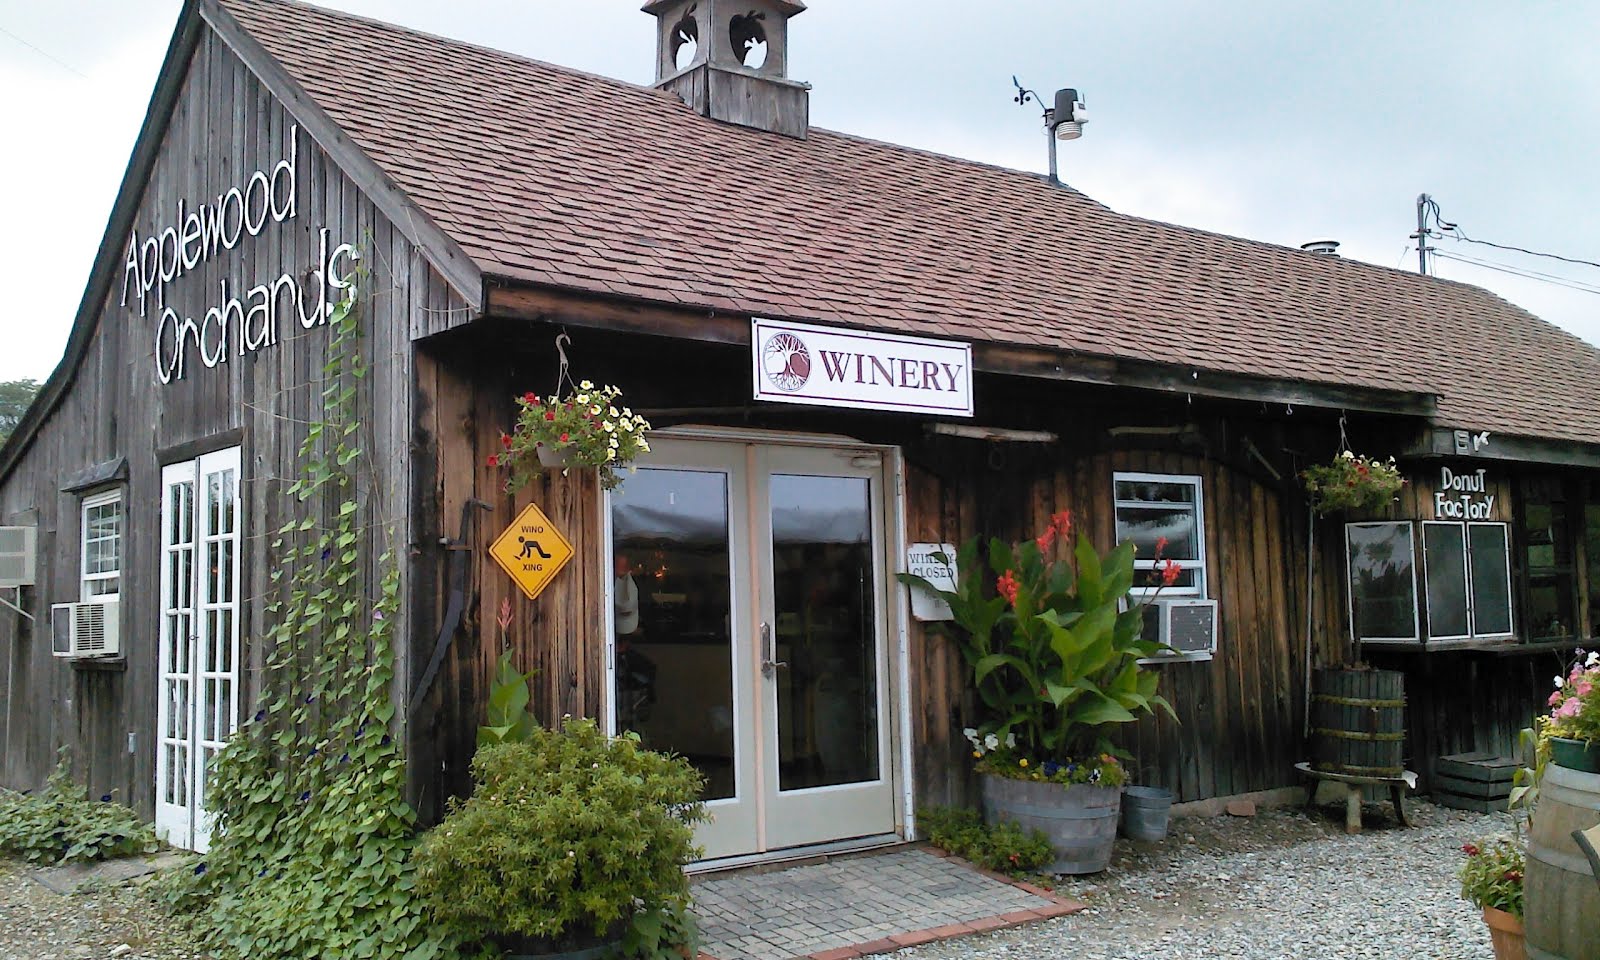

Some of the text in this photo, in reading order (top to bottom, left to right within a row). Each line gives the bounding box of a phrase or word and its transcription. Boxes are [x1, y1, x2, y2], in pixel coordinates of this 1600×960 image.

[121, 124, 297, 317] Applewood
[155, 227, 360, 385] Orchards
[818, 349, 963, 392] WINERY
[521, 525, 544, 534] WINO
[522, 563, 543, 572] XING
[913, 566, 954, 578] CLOSED
